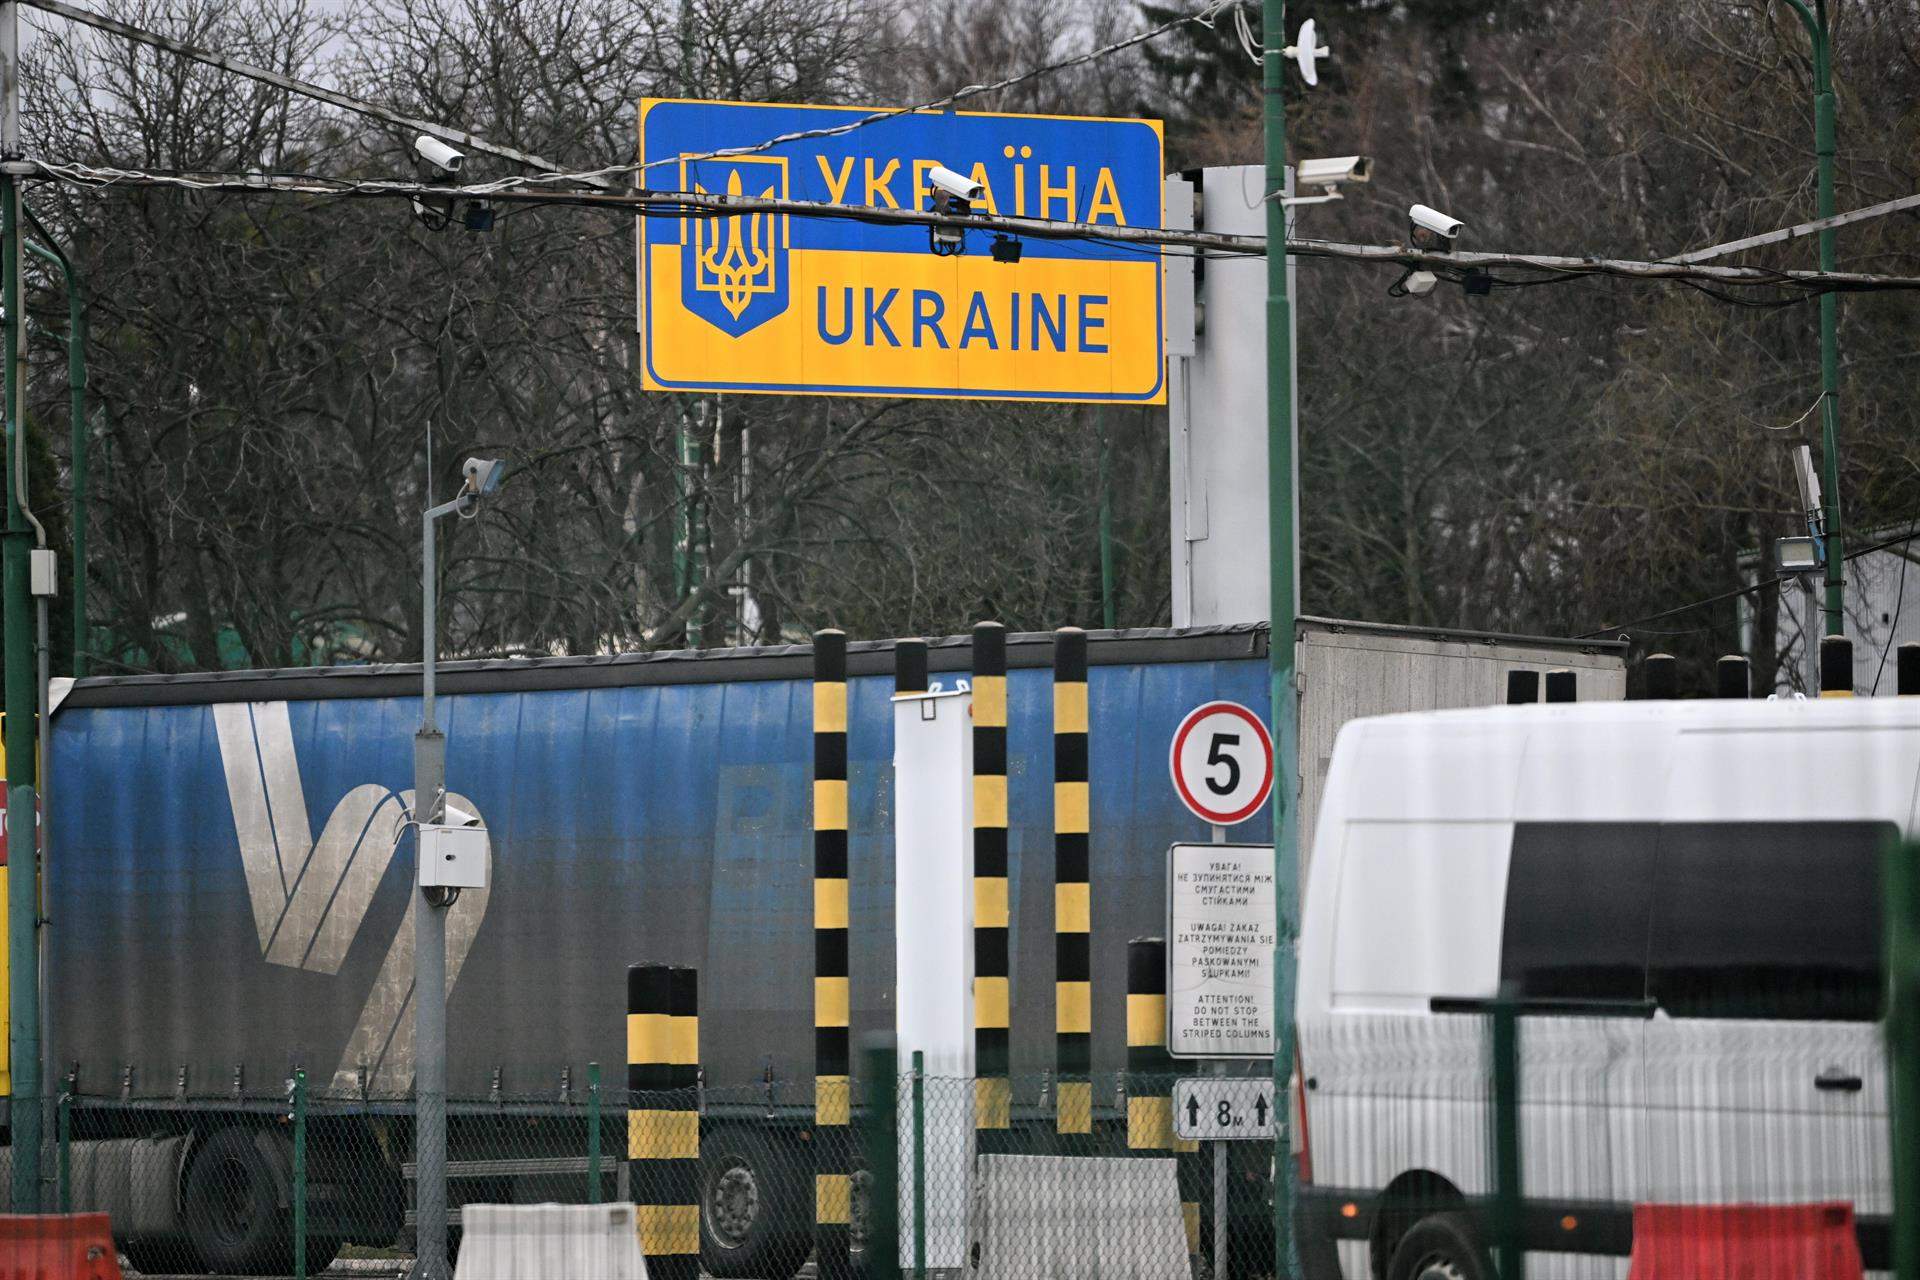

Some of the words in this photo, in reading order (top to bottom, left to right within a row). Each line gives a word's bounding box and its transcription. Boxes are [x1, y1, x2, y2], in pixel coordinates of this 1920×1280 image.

[816, 286, 1110, 354] UKRAINE
[1205, 733, 1240, 796] 5
[1209, 863, 1241, 872] УВАГА!
[1178, 873, 1188, 882] НЕ
[1193, 873, 1251, 883] ЗУПИНЯТИСЯ
[1254, 875, 1273, 883] МІЖ
[1195, 885, 1255, 894] СМУГАСТИМИ
[1202, 895, 1248, 905] СТІЙКАМИ
[1191, 923, 1226, 932] UWAGA!
[1230, 923, 1259, 933] ZAKAZ
[1178, 934, 1256, 944] ZATRZYMYWANIA
[1198, 994, 1254, 1004] ATTENTION!
[1194, 1006, 1206, 1015] DO
[1211, 1006, 1229, 1015] NOT
[1234, 1006, 1258, 1015] STOP
[1193, 1018, 1237, 1027] BETWEEN
[1242, 1018, 1259, 1027] THE
[1183, 1029, 1221, 1038] STRIPED
[1226, 1030, 1270, 1038] COLUMNS
